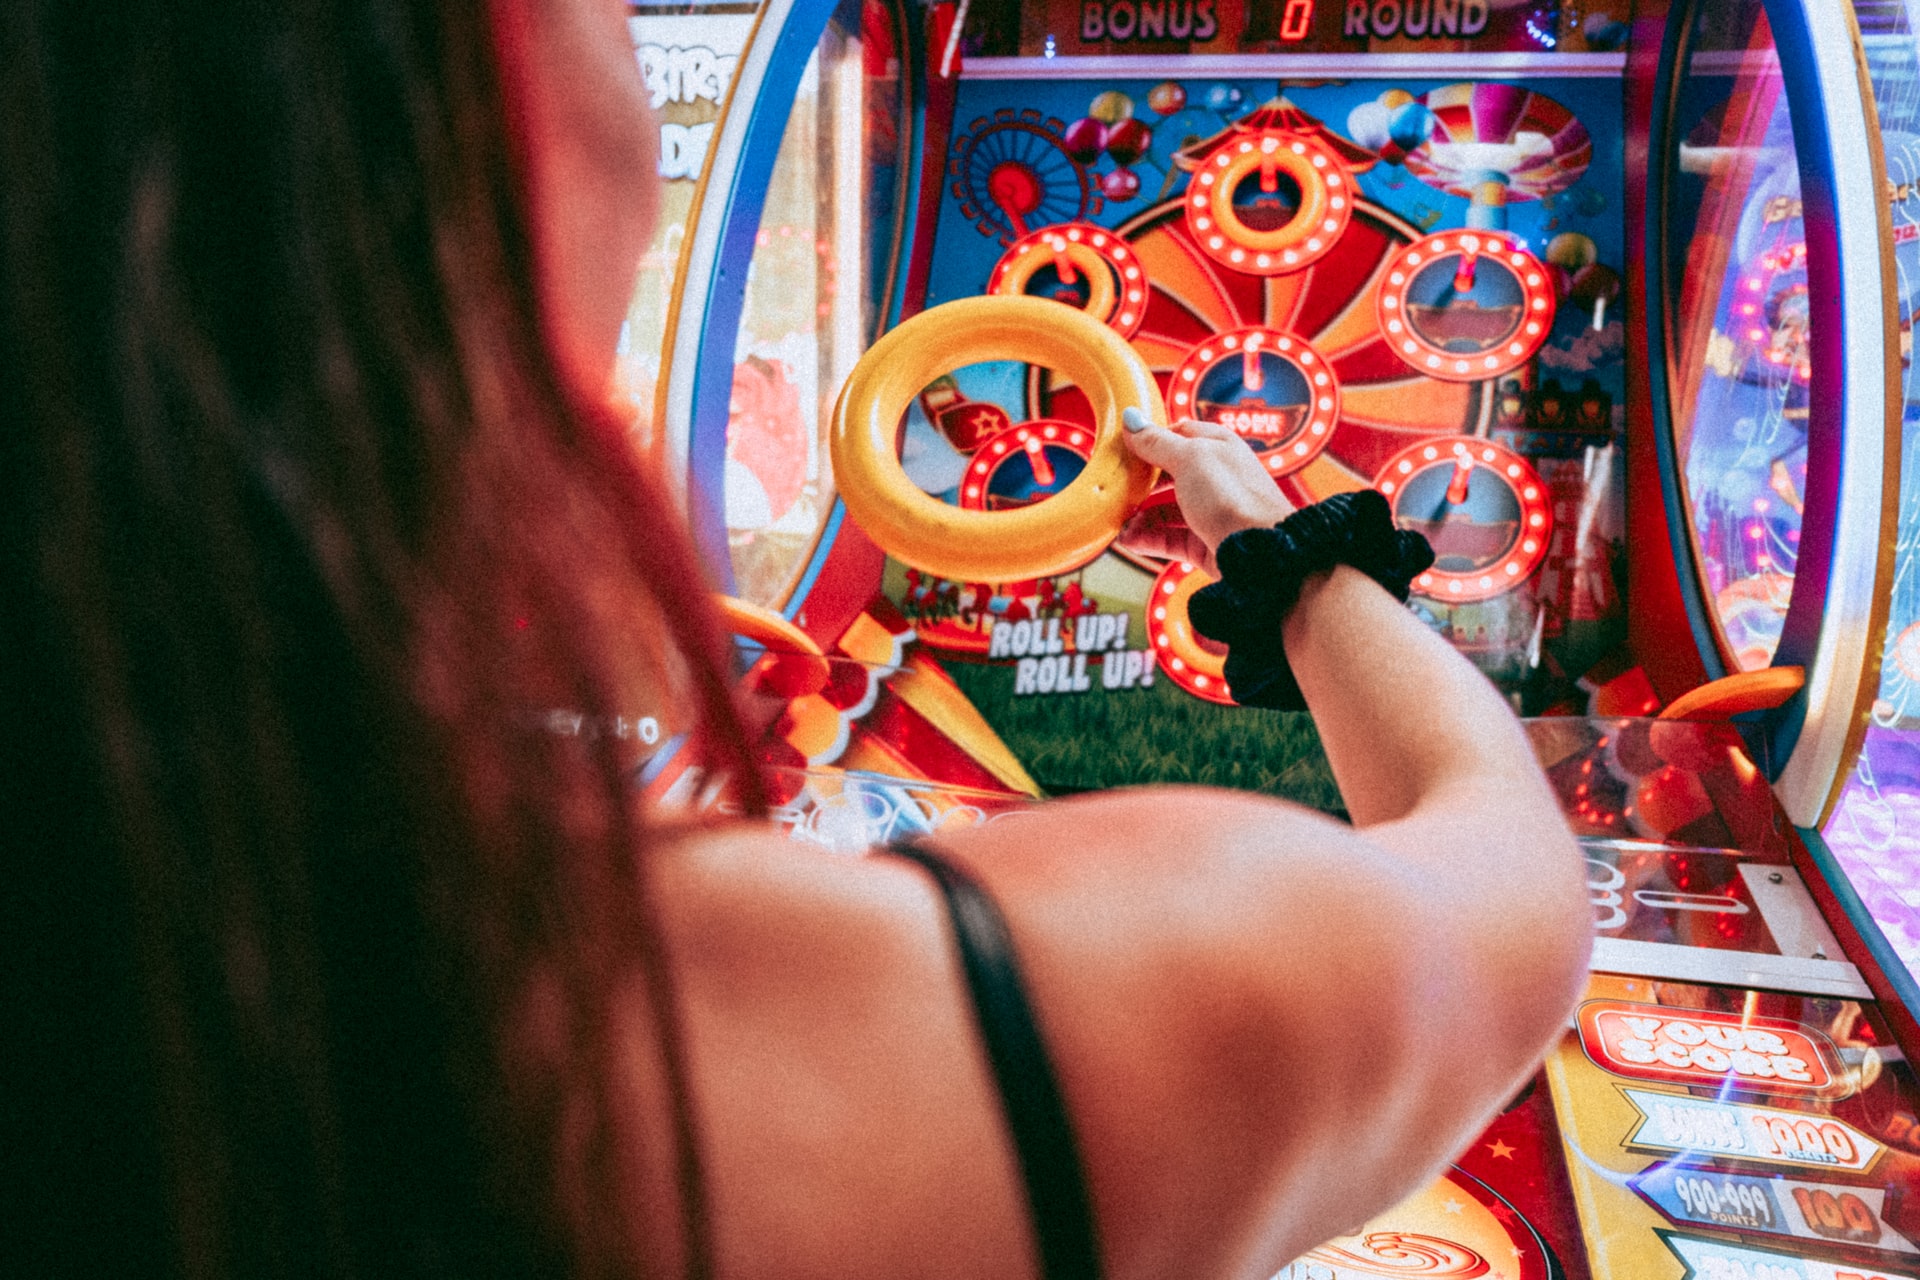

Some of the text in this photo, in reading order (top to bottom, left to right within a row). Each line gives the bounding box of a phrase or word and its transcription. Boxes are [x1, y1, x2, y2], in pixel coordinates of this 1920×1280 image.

[1082, 0, 1217, 39] BONUS
[1344, 0, 1488, 37] ROUND
[990, 614, 1128, 658] ROLL UP!
[1015, 650, 1155, 694] ROLL UP!
[1620, 1017, 1789, 1056] YOUR
[1618, 1038, 1814, 1083] SCORE
[1752, 1115, 1859, 1165] 1000
[1675, 1176, 1877, 1244] 900-999 100
[1710, 1211, 1759, 1227] POINTS
